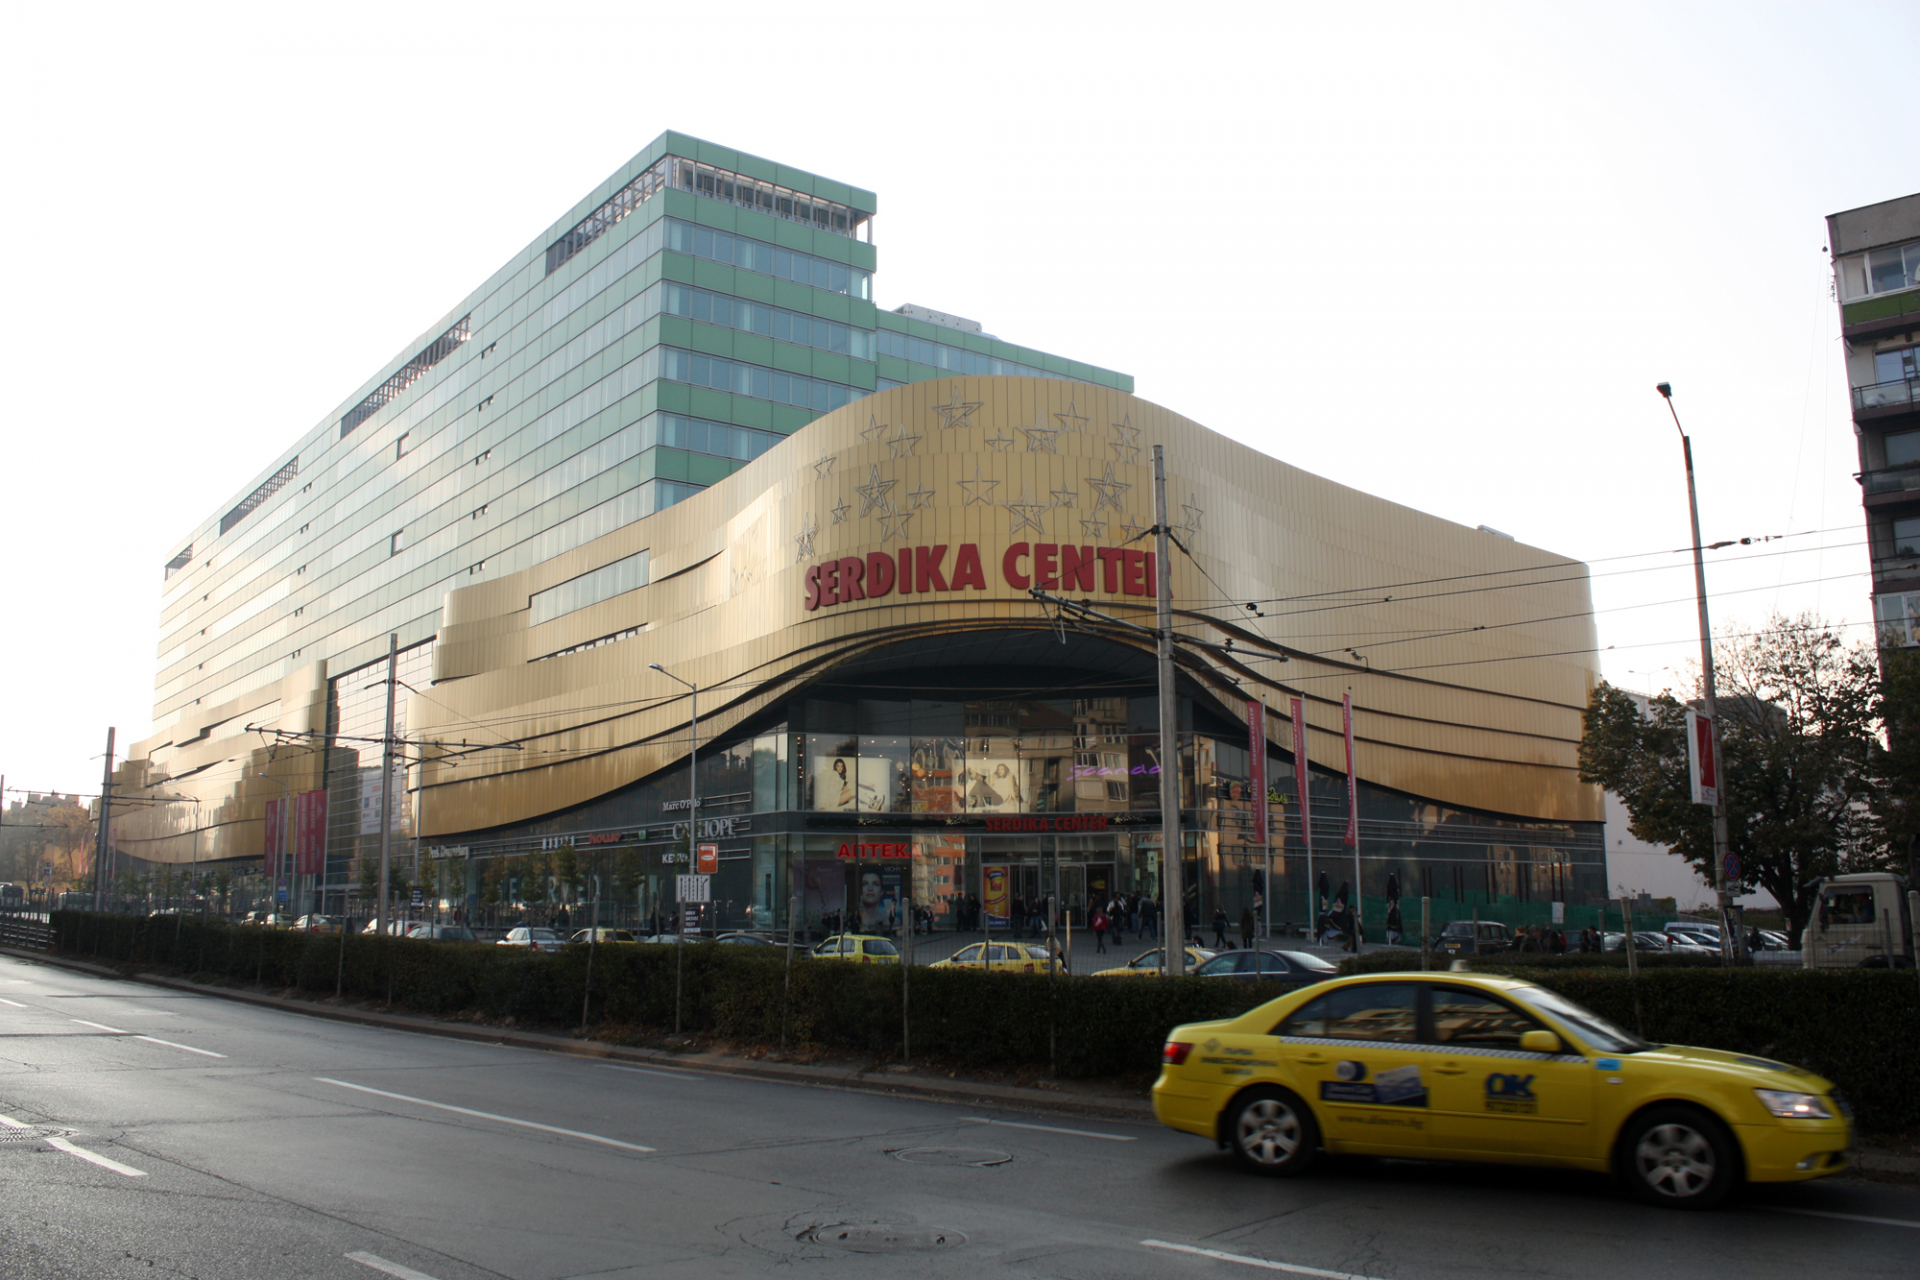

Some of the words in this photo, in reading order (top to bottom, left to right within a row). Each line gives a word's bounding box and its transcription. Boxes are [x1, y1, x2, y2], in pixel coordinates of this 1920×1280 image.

[805, 543, 986, 611] SERDIKA
[662, 801, 679, 811] Marc
[680, 799, 701, 809] O'Plo
[673, 818, 736, 840] CALIOPE
[985, 816, 1049, 832] SERDIKA
[1054, 815, 1108, 831] CENTER
[1486, 1073, 1535, 1097] OK
